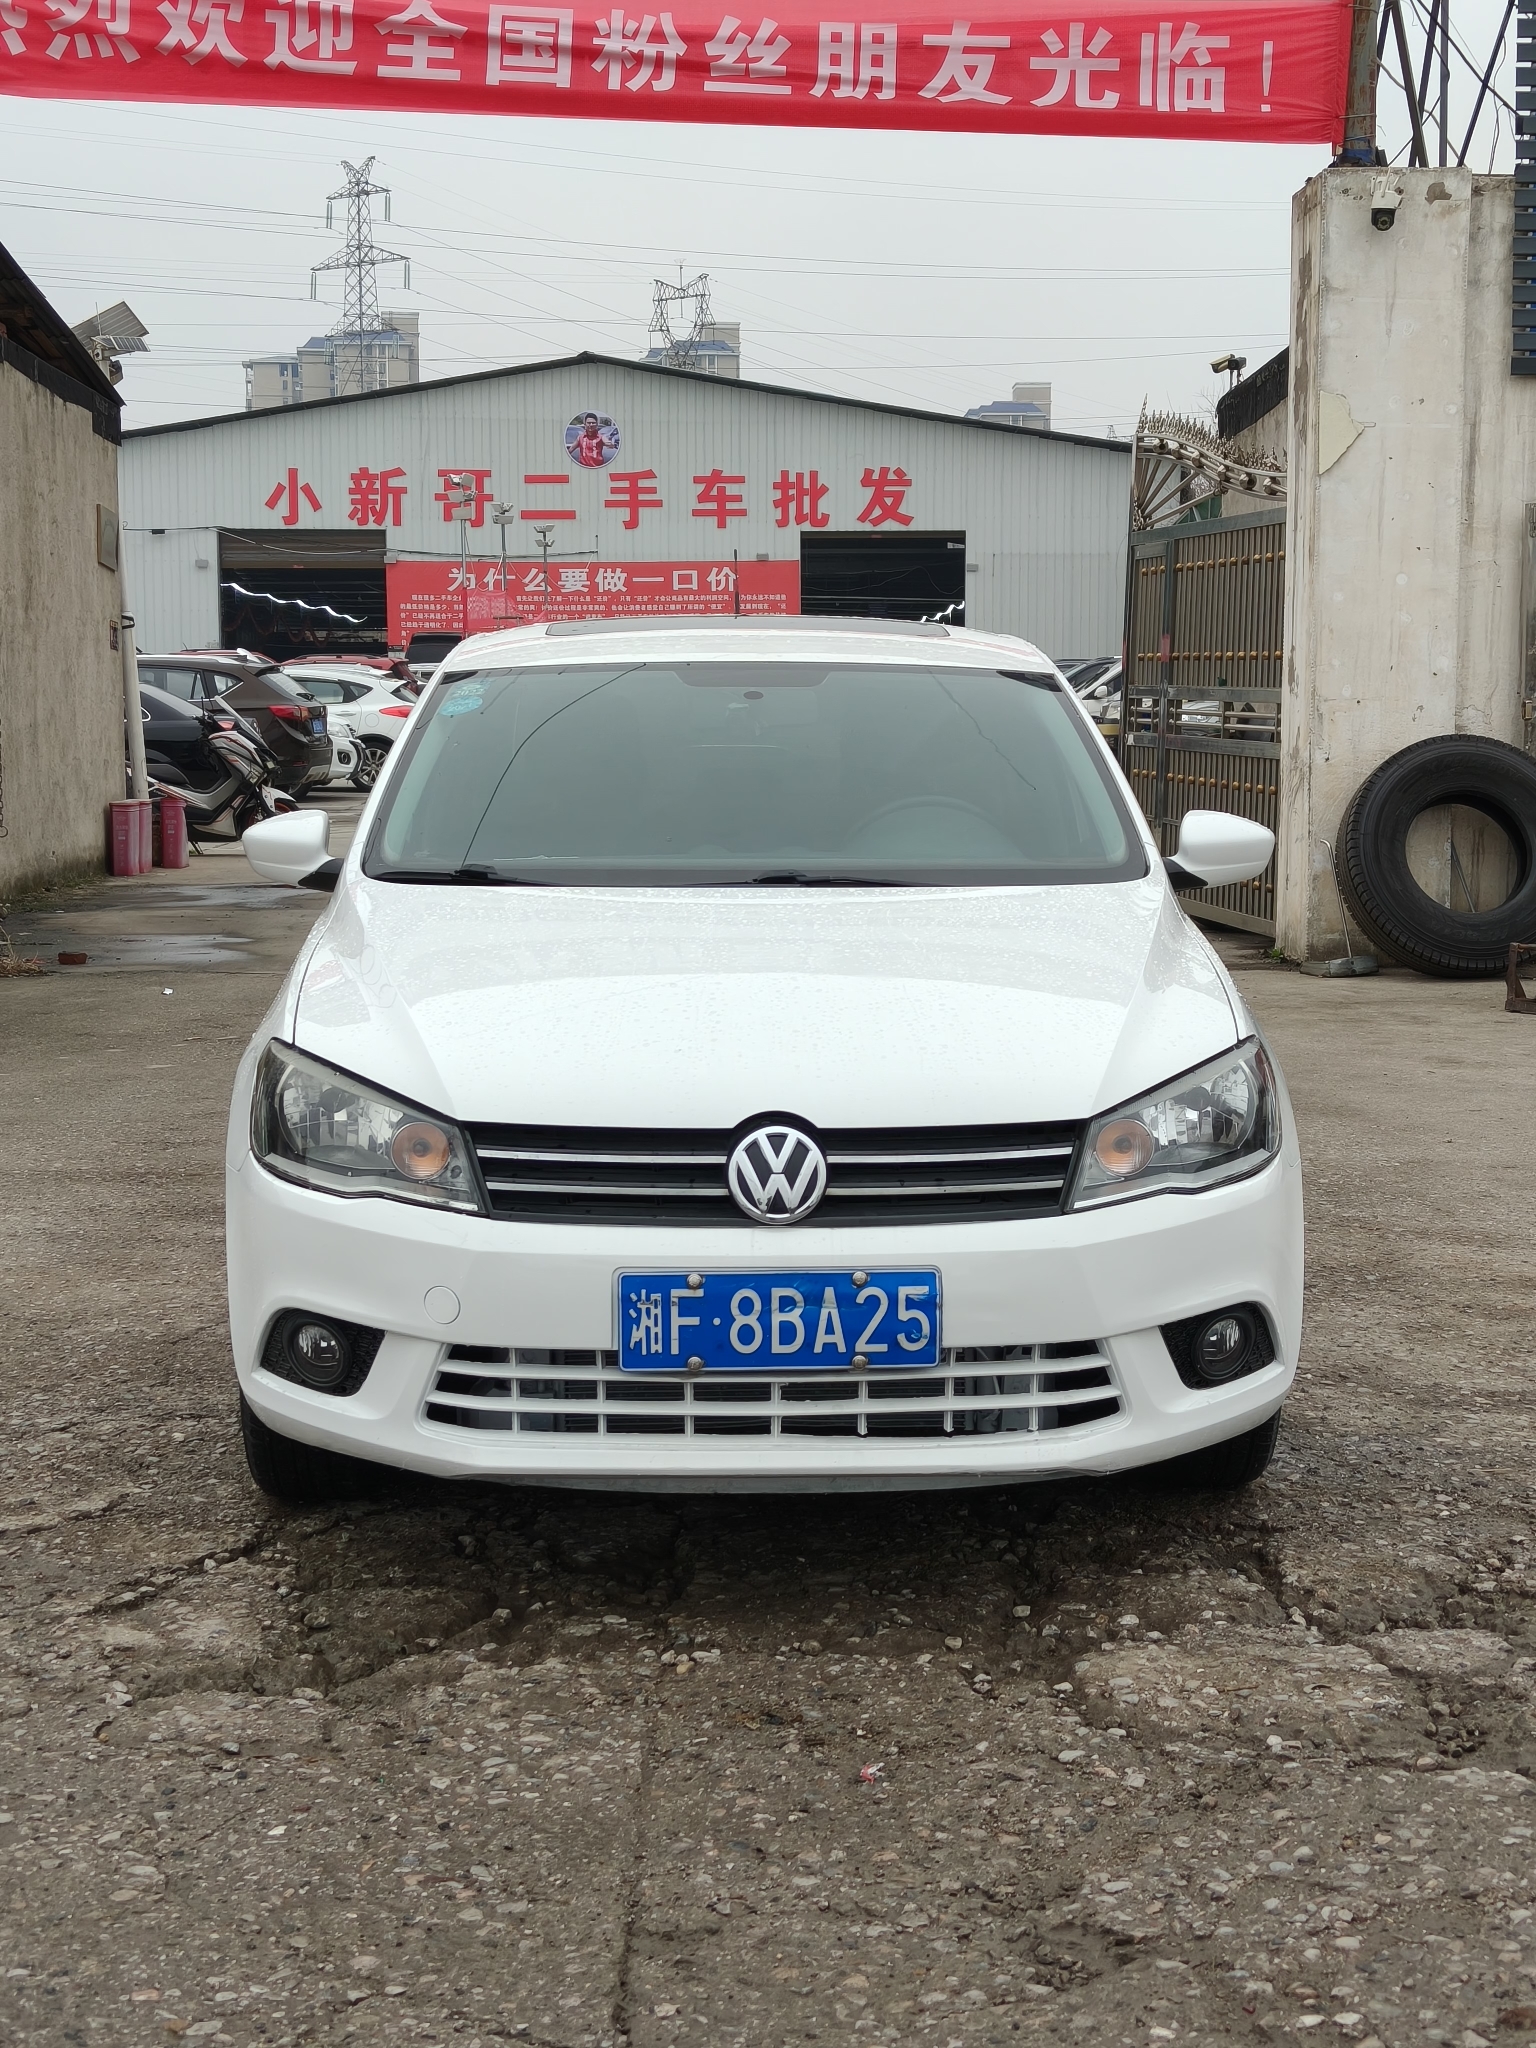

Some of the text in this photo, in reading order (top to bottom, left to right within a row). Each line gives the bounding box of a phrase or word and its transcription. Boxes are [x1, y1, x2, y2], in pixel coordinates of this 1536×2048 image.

[265, 466, 914, 529] 小新哥二手车批发
[446, 567, 739, 593] 为什么要做一口价
